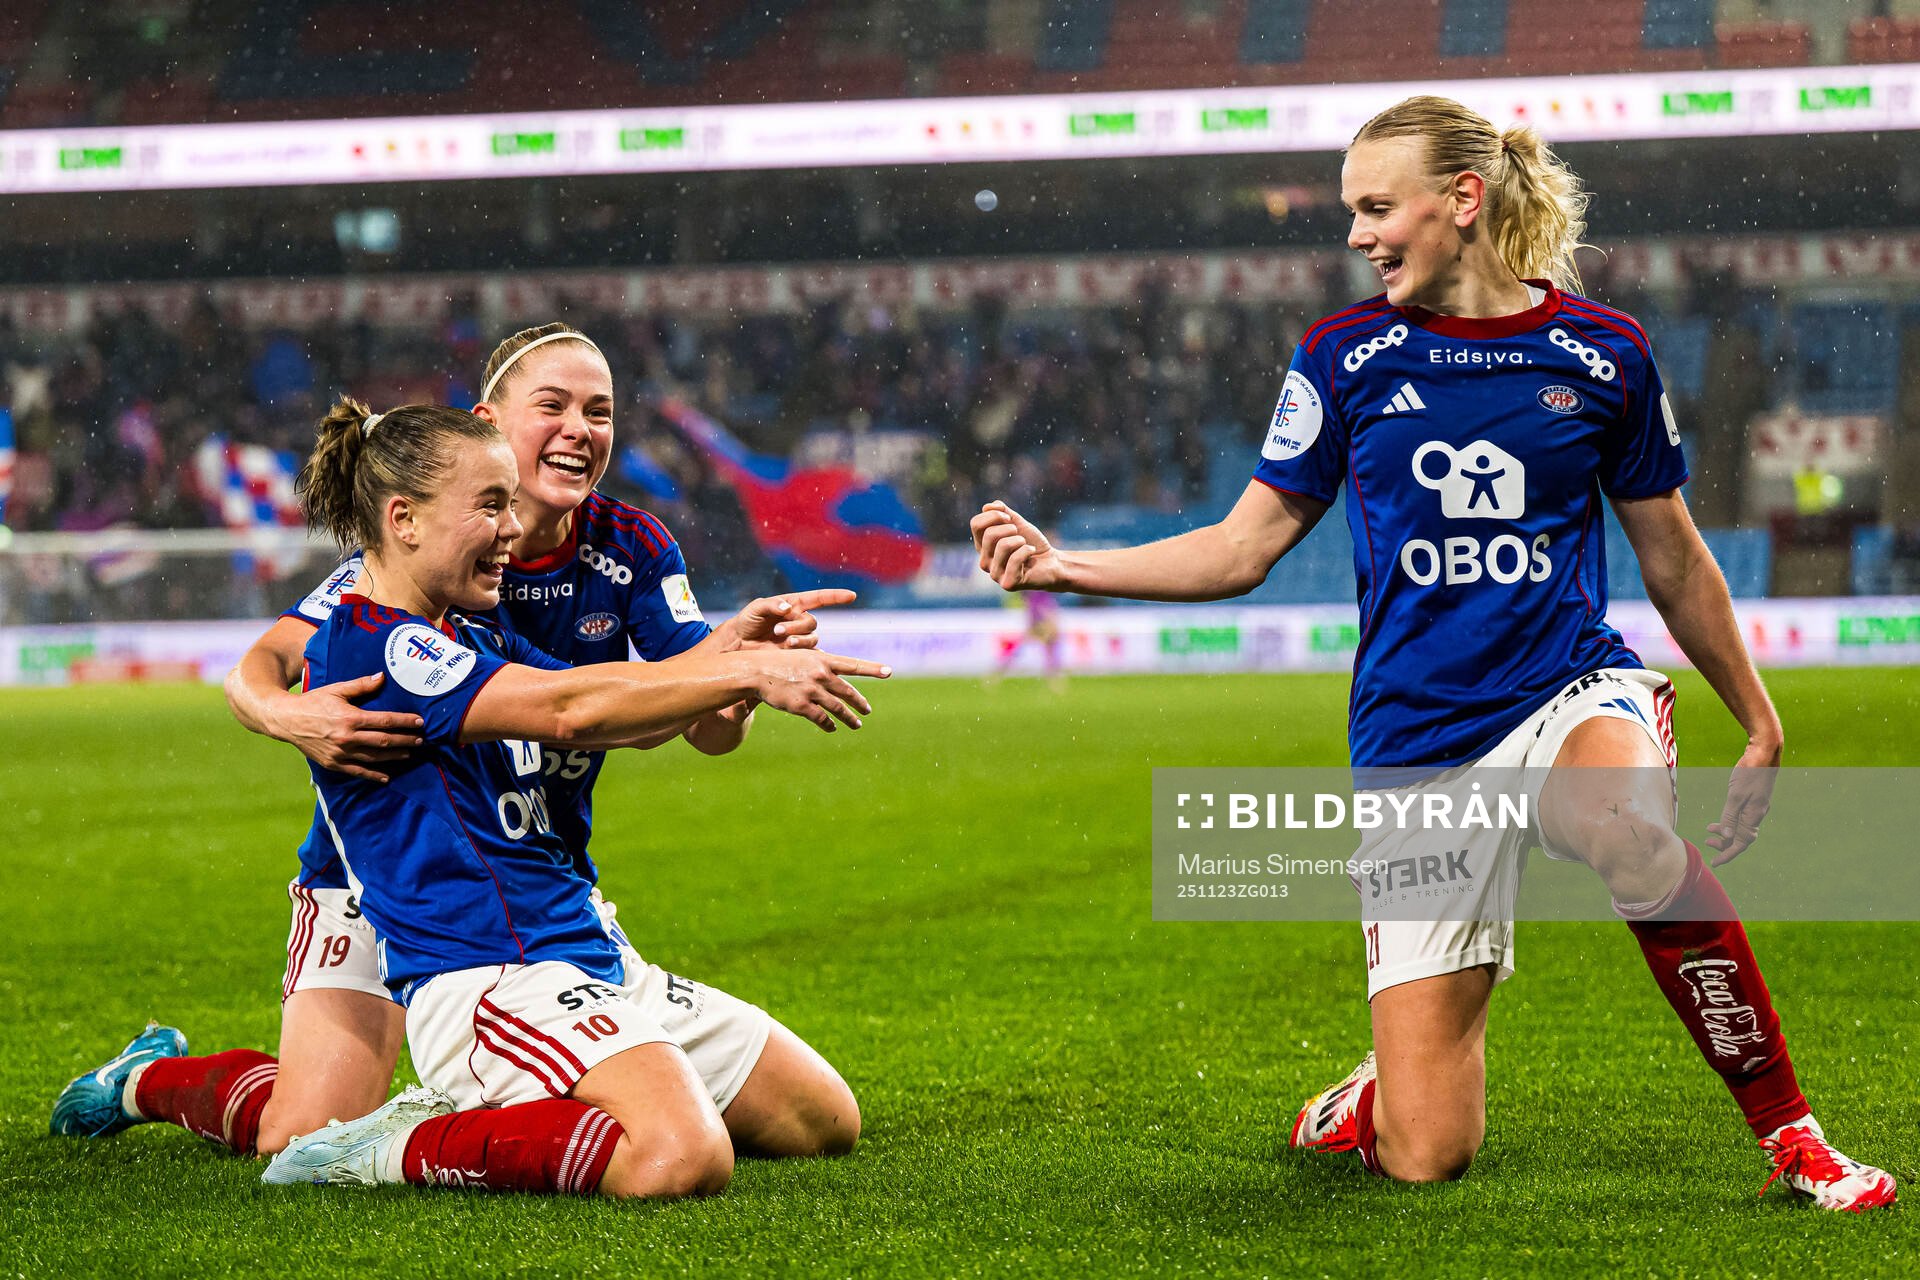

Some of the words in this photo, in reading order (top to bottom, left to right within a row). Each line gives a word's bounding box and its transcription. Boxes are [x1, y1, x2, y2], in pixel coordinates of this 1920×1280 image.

[1343, 323, 1409, 373] coop
[1548, 327, 1617, 382] coop
[1272, 433, 1291, 448] KIWI
[578, 543, 633, 585] coop
[1400, 533, 1553, 586] OBOS
[318, 600, 335, 610] KIW
[445, 653, 465, 669] KIWI
[1416, 884, 1475, 899] TRENING
[318, 935, 352, 969] 19
[571, 1014, 620, 1042] 10
